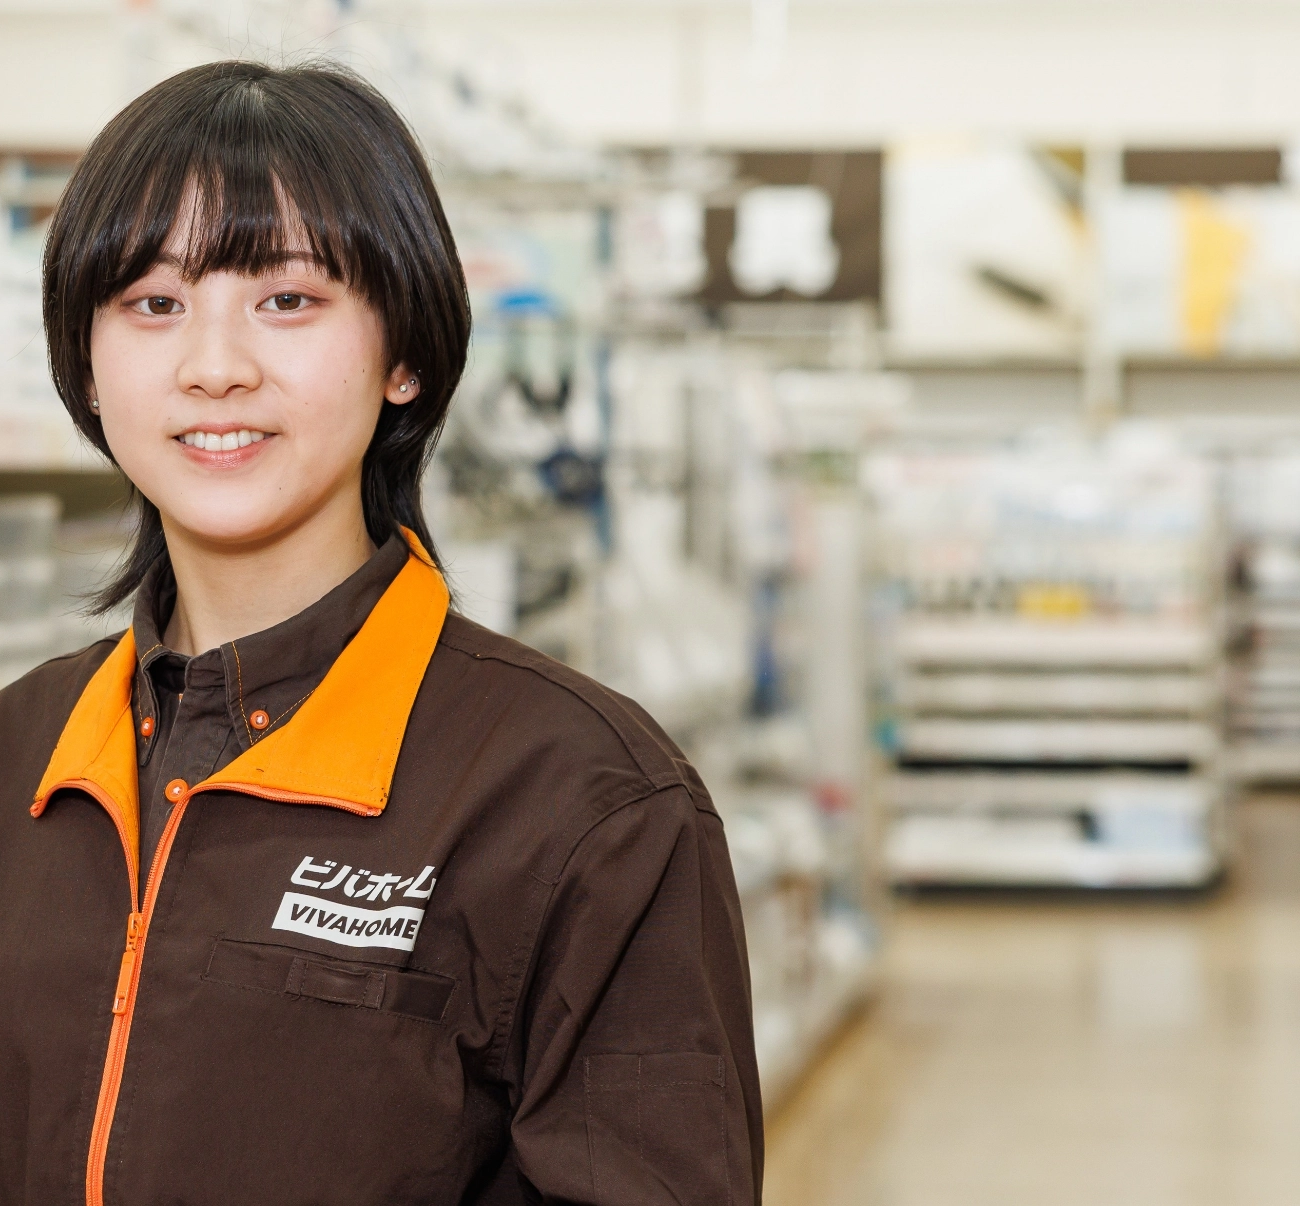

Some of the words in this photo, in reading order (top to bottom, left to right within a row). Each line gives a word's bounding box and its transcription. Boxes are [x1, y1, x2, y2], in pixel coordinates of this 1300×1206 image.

[290, 855, 437, 902] ビバホーム
[290, 903, 419, 940] VIVAHOME
